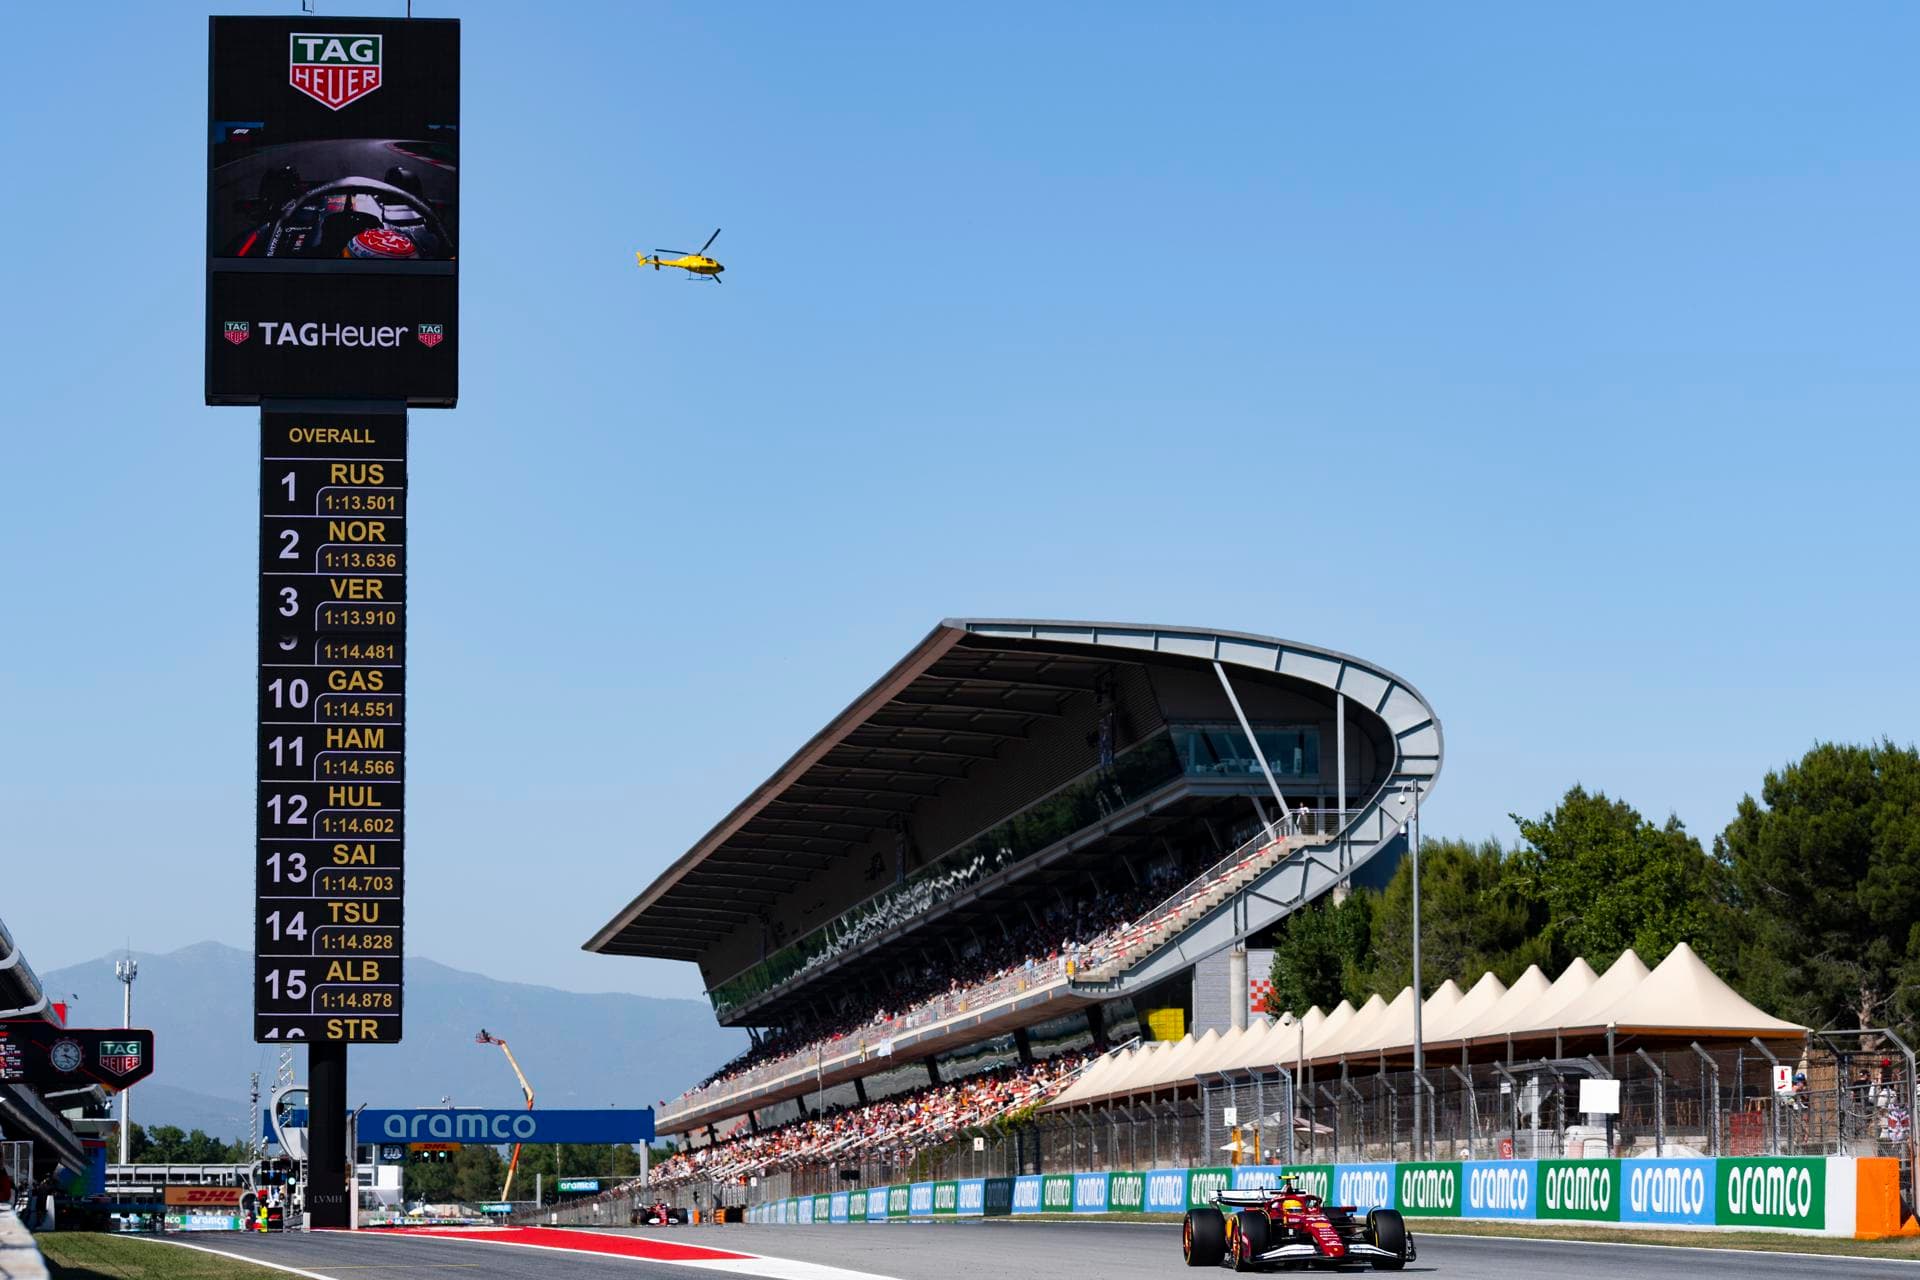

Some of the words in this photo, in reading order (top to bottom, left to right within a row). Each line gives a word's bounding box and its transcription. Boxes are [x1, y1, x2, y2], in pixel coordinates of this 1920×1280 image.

[298, 38, 374, 62] TAG
[296, 68, 376, 104] HEUER
[226, 323, 247, 331] TAG
[420, 325, 441, 333] TAG
[289, 428, 375, 443] OVERALL
[330, 463, 385, 486] RUS
[281, 471, 296, 502] 1
[325, 495, 395, 511] 1:13.501
[329, 521, 386, 542] NOR
[279, 529, 299, 559] 2
[325, 552, 397, 568] 1:13.636
[330, 578, 384, 600] VER
[279, 586, 299, 617] 3
[325, 610, 396, 626] 1:13.910
[324, 644, 394, 660] 1:14.481
[328, 669, 384, 692] GAS
[268, 678, 309, 709] 10
[324, 701, 393, 717] 1:14.551
[326, 727, 385, 749] HAM
[268, 736, 303, 767] 11
[323, 759, 395, 775] 1:14.566
[329, 785, 382, 807] HUL
[267, 794, 308, 825] 12
[322, 817, 395, 833] 1:14.602
[332, 843, 376, 865] SAI
[266, 852, 307, 883] 13
[322, 876, 393, 891] 1:14.703
[328, 902, 379, 923] TSU
[265, 910, 308, 941] 14
[321, 934, 393, 949] 1:14.828
[326, 960, 380, 982] ALB
[264, 969, 307, 1000] 15
[321, 993, 392, 1008] 1:14.878
[327, 1018, 379, 1039] STR
[103, 1043, 138, 1054] TAG
[102, 1057, 139, 1073] HEUER
[383, 1114, 537, 1139] aramco
[187, 1190, 239, 1203] DHL
[560, 1181, 596, 1190] aramco
[1014, 1181, 1039, 1207] aramco
[1045, 1179, 1071, 1206] aramco
[1077, 1178, 1105, 1206] aramco
[1112, 1177, 1142, 1206] aramco
[1150, 1175, 1183, 1206] aramco
[1340, 1171, 1388, 1208] aramco
[1402, 1169, 1455, 1208] aramco
[1470, 1168, 1529, 1210] aramco
[1545, 1167, 1611, 1212] aramco
[1631, 1167, 1704, 1215] aramco
[1728, 1166, 1812, 1217] aramco
[191, 1215, 228, 1226] aramco
